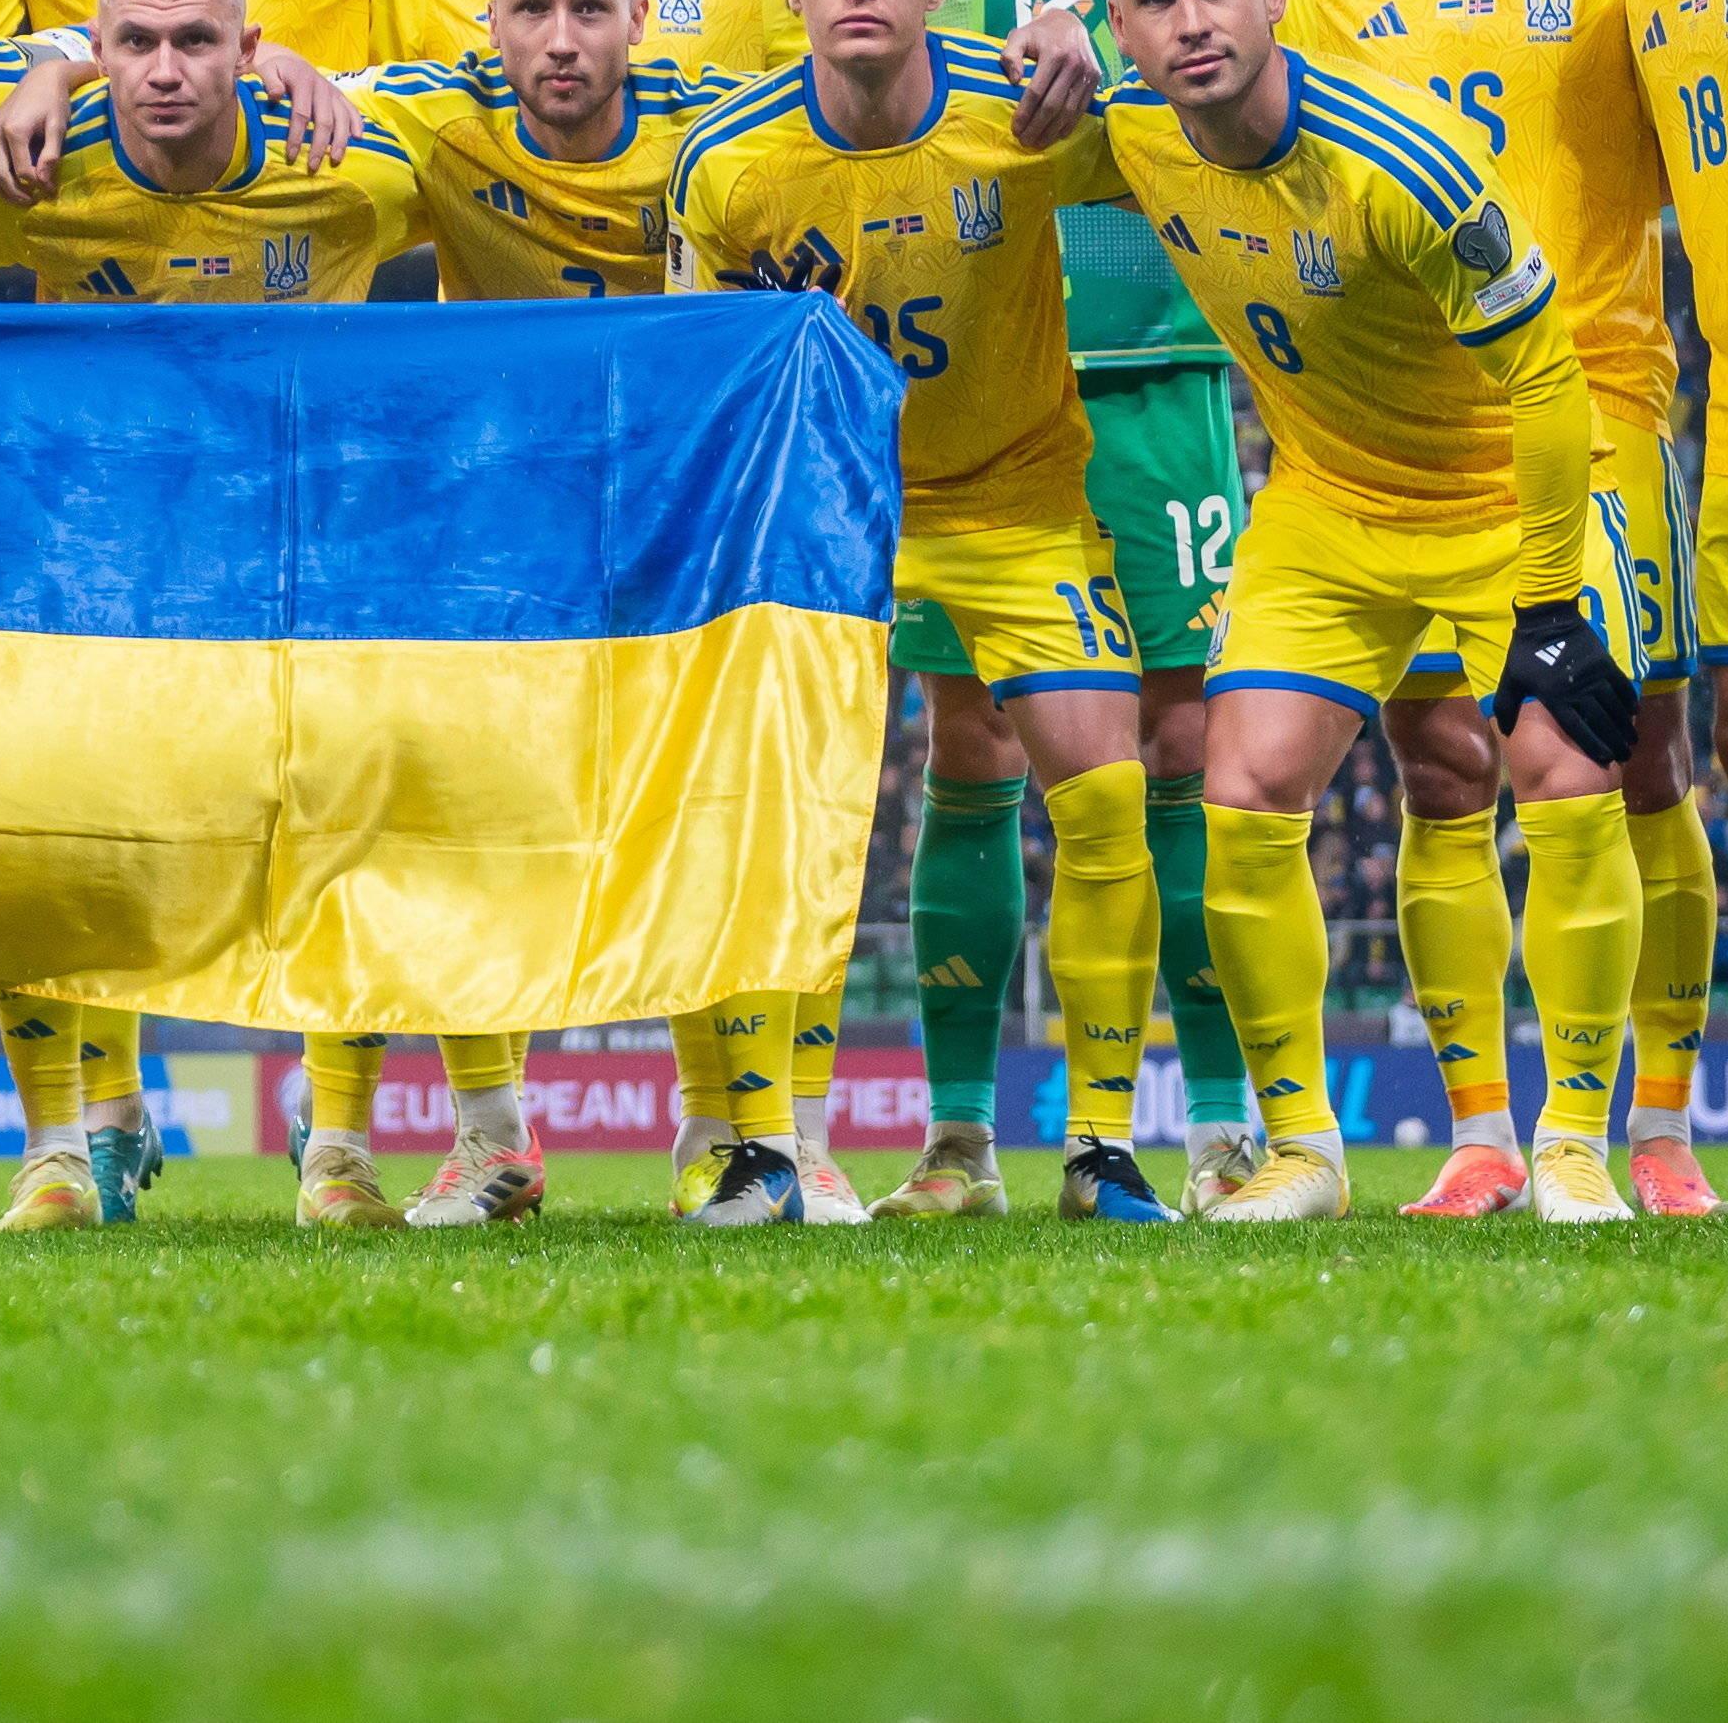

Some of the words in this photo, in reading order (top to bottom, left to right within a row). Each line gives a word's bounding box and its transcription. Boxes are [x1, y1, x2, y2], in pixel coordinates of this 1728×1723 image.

[1527, 35, 1573, 43] UKRAINE
[1679, 75, 1728, 173] 18
[1245, 302, 1304, 374] 8
[1166, 494, 1234, 587] 12
[1054, 575, 1133, 658] 15
[713, 1013, 767, 1037] UAF
[1084, 1021, 1142, 1045] UAF
[1554, 1022, 1615, 1046] UAF
[373, 1081, 657, 1133] EUPEAN
